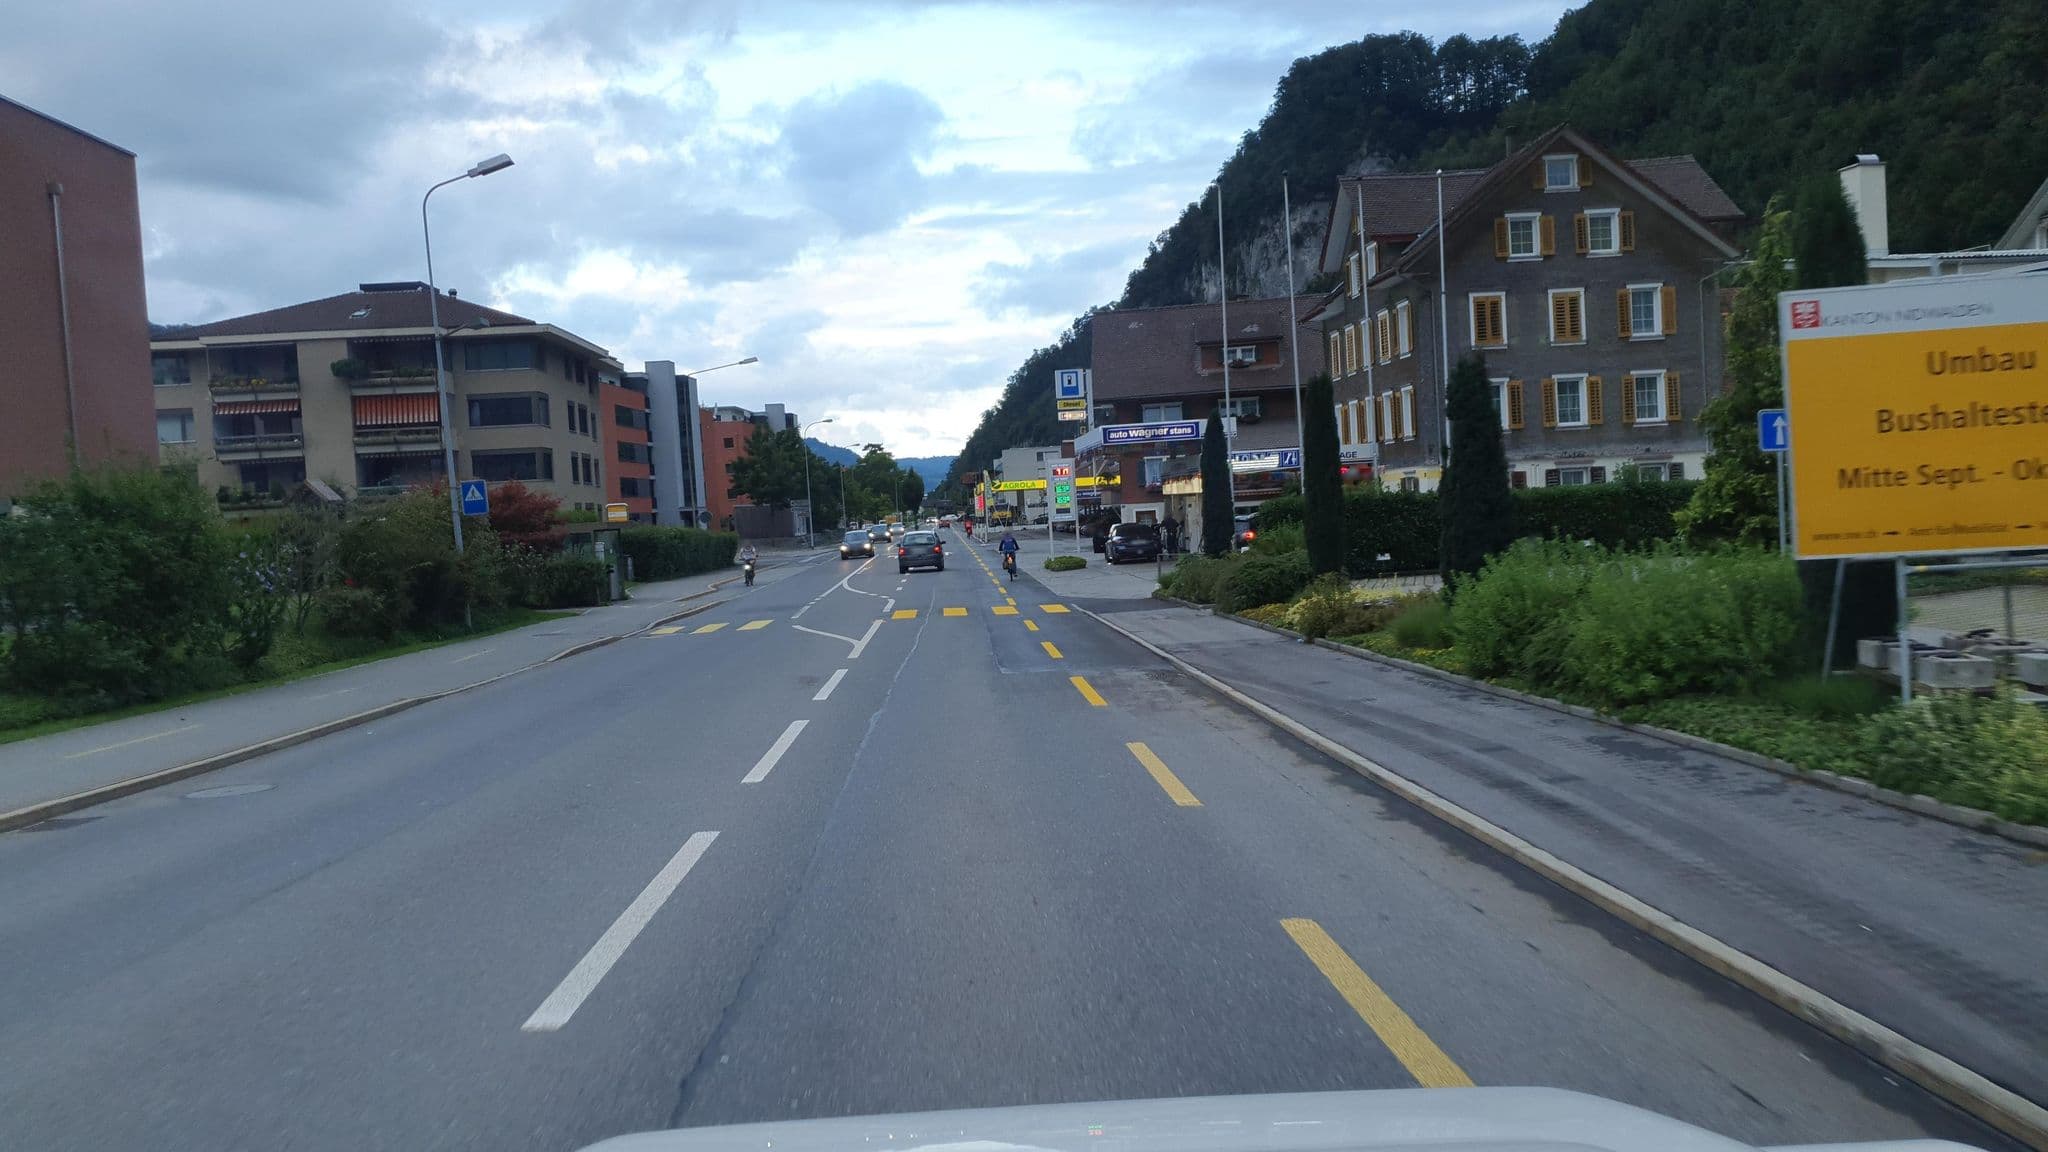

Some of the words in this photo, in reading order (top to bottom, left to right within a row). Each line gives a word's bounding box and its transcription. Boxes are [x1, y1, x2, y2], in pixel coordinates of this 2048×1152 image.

[1926, 345, 2038, 375] Umbau
[1109, 430, 1128, 439] auto
[1169, 427, 1192, 435] stans
[1003, 481, 1036, 489] AGROLA
[1837, 466, 1910, 489] Mitte
[1916, 463, 1985, 491] Sept.
